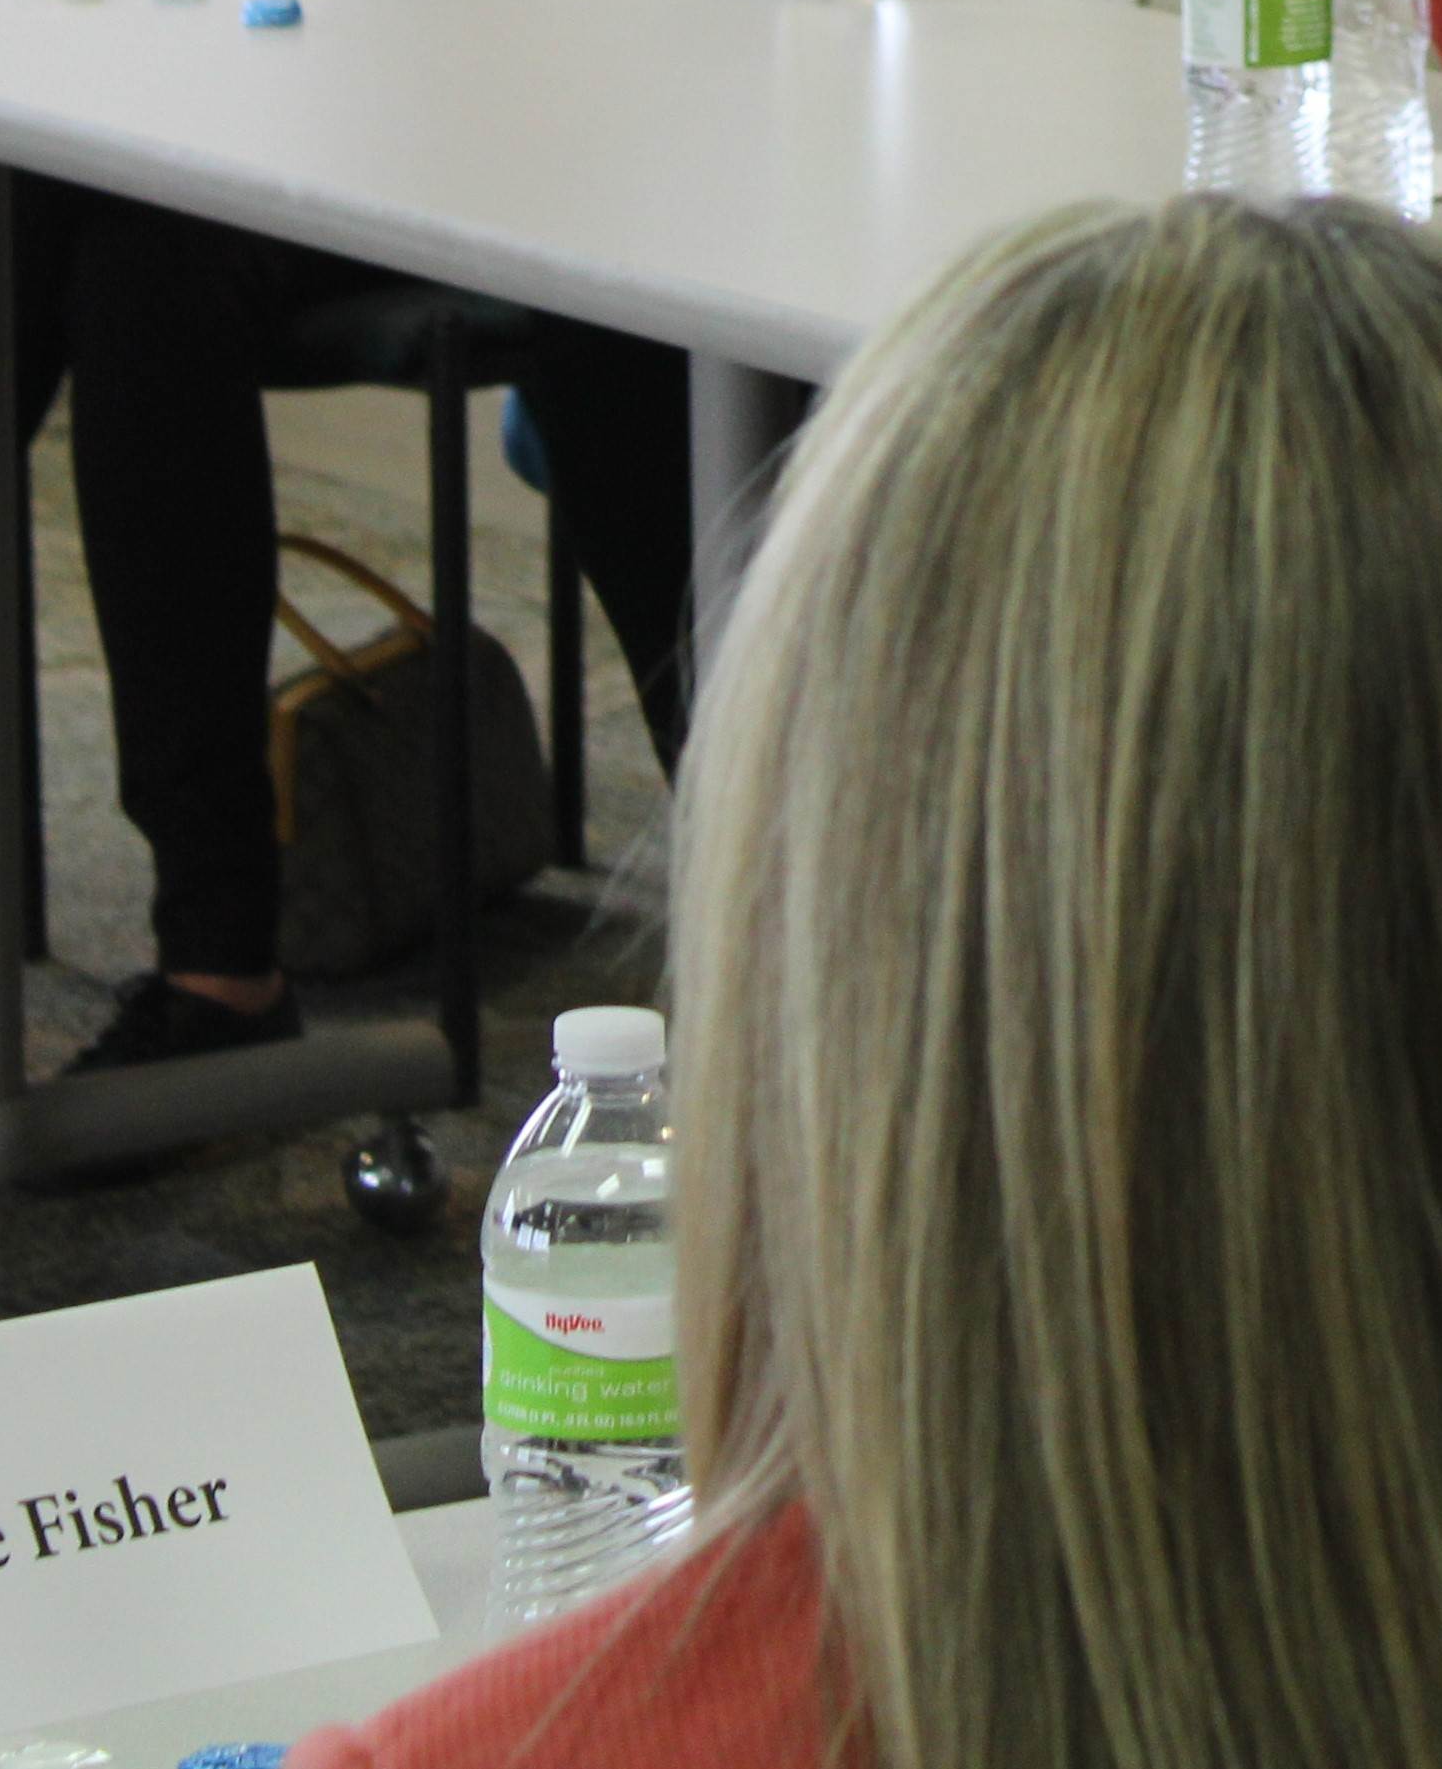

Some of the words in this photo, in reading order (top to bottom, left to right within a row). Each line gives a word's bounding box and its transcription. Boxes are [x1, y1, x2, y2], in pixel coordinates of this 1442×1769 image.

[499, 1369, 588, 1403] drinking
[601, 1379, 671, 1398] water
[18, 1475, 229, 1561] Fisher
